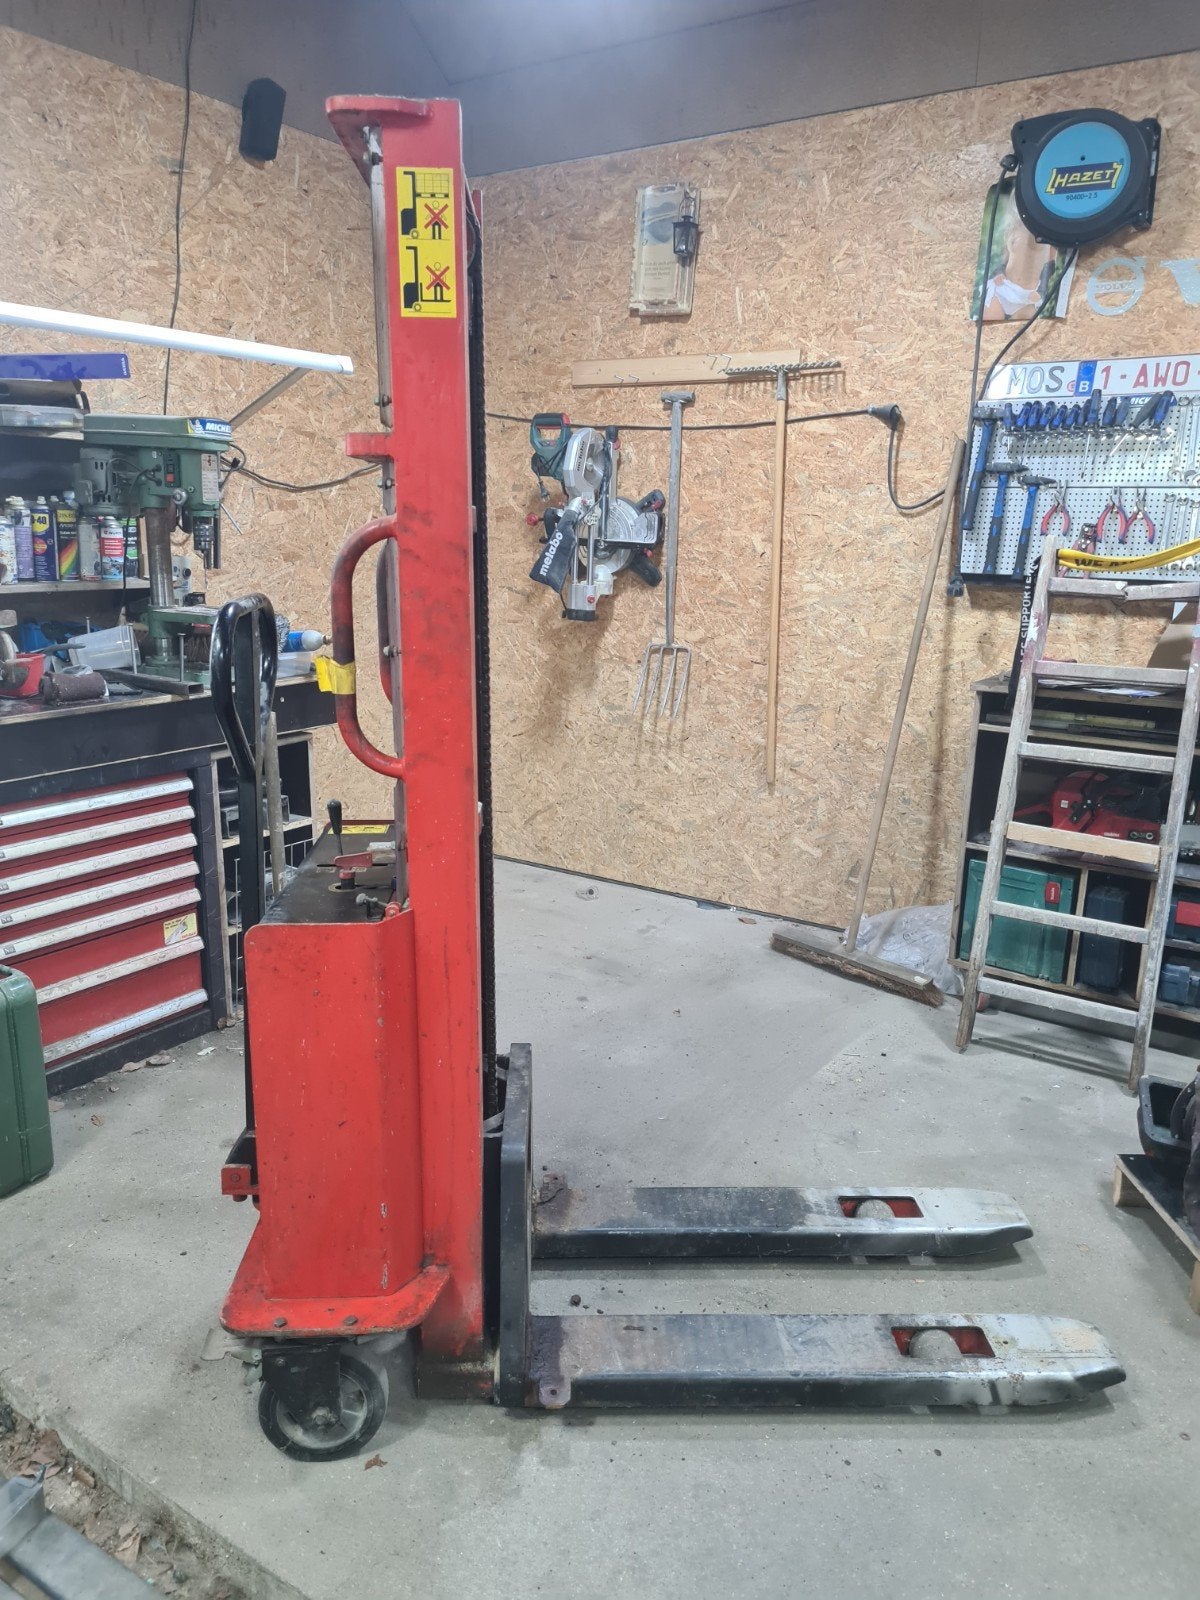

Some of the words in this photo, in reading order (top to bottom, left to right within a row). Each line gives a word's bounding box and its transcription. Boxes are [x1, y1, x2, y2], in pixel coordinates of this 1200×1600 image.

[1054, 169, 1115, 188] HAZET
[1006, 365, 1065, 395] MOS
[1078, 380, 1090, 393] B
[540, 532, 563, 577] metabo
